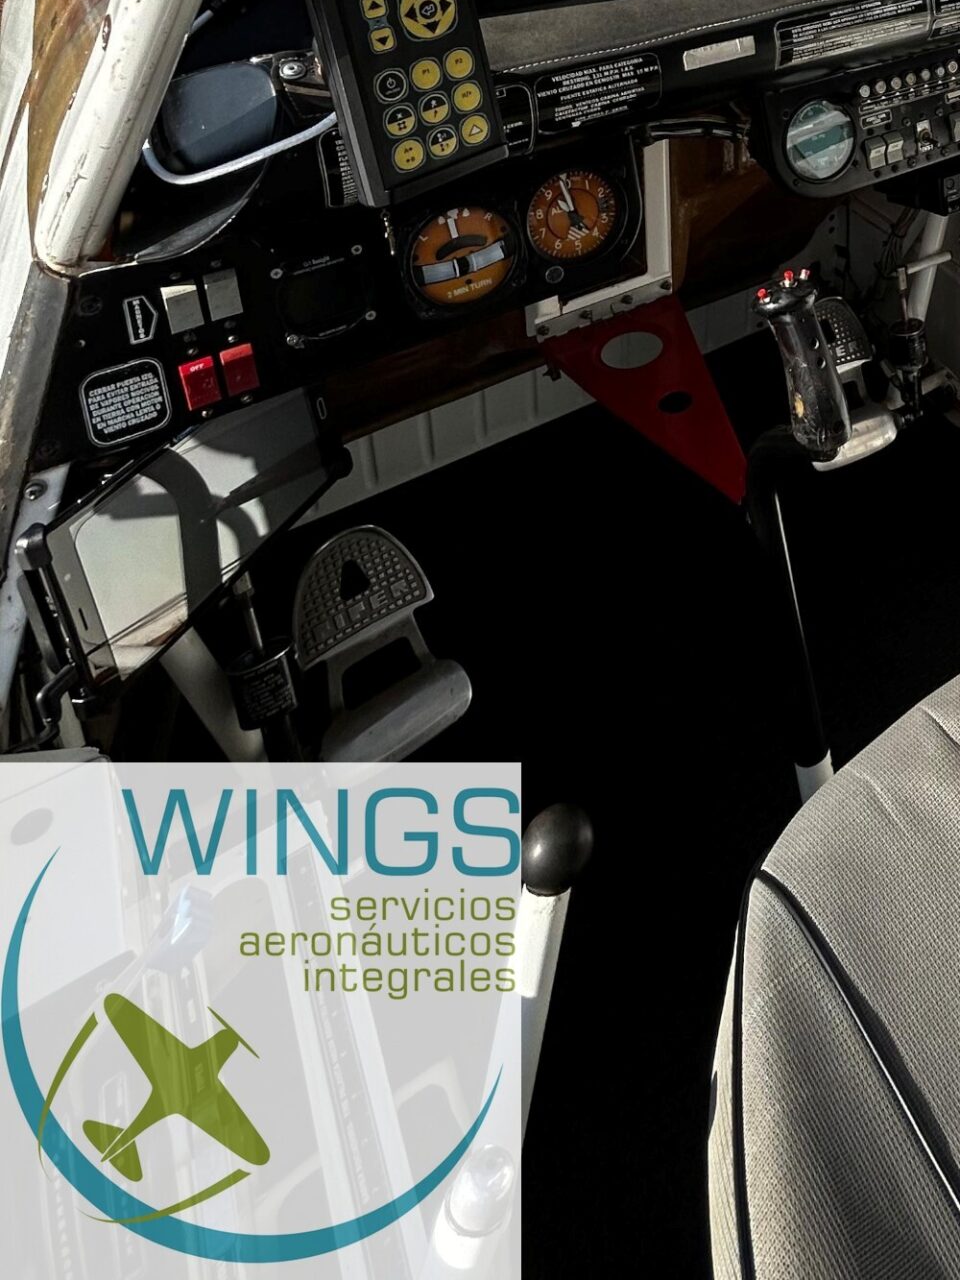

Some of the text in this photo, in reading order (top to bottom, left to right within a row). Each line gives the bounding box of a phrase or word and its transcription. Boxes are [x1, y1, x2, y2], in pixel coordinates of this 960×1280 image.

[552, 70, 583, 82] VELOCIDAD
[614, 57, 643, 68] CATEGORIA
[537, 88, 558, 98] VIENTO
[558, 82, 584, 93] CRUZADO
[560, 92, 581, 101] FUENTE
[582, 86, 607, 96] ESTATICA
[544, 189, 553, 201] 9
[597, 187, 605, 198] 2
[484, 212, 493, 221] R
[535, 209, 543, 219] 8
[600, 214, 609, 223] 3
[539, 228, 546, 239] 7
[592, 226, 599, 236] 4
[419, 234, 429, 242] L
[554, 240, 562, 250] 6
[575, 240, 582, 250] 5
[453, 284, 470, 297] MIN
[471, 278, 493, 292] TURN
[189, 363, 205, 372] OFF
[88, 378, 159, 404] PARA EVITAR ENTRADA
[89, 384, 116, 397] CERRAR
[116, 376, 141, 388] PUERTA
[90, 403, 99, 411] DE
[100, 393, 130, 407] VAPORES
[92, 391, 160, 416] DURANTE OPERACION
[102, 409, 125, 420] TIERRA
[126, 404, 140, 412] CON
[140, 396, 163, 407] MOTOR
[97, 422, 107, 430] EN
[107, 412, 135, 425] MARCHA
[135, 405, 155, 416] LENTA
[103, 411, 158, 434] VIENTO CRUZADO
